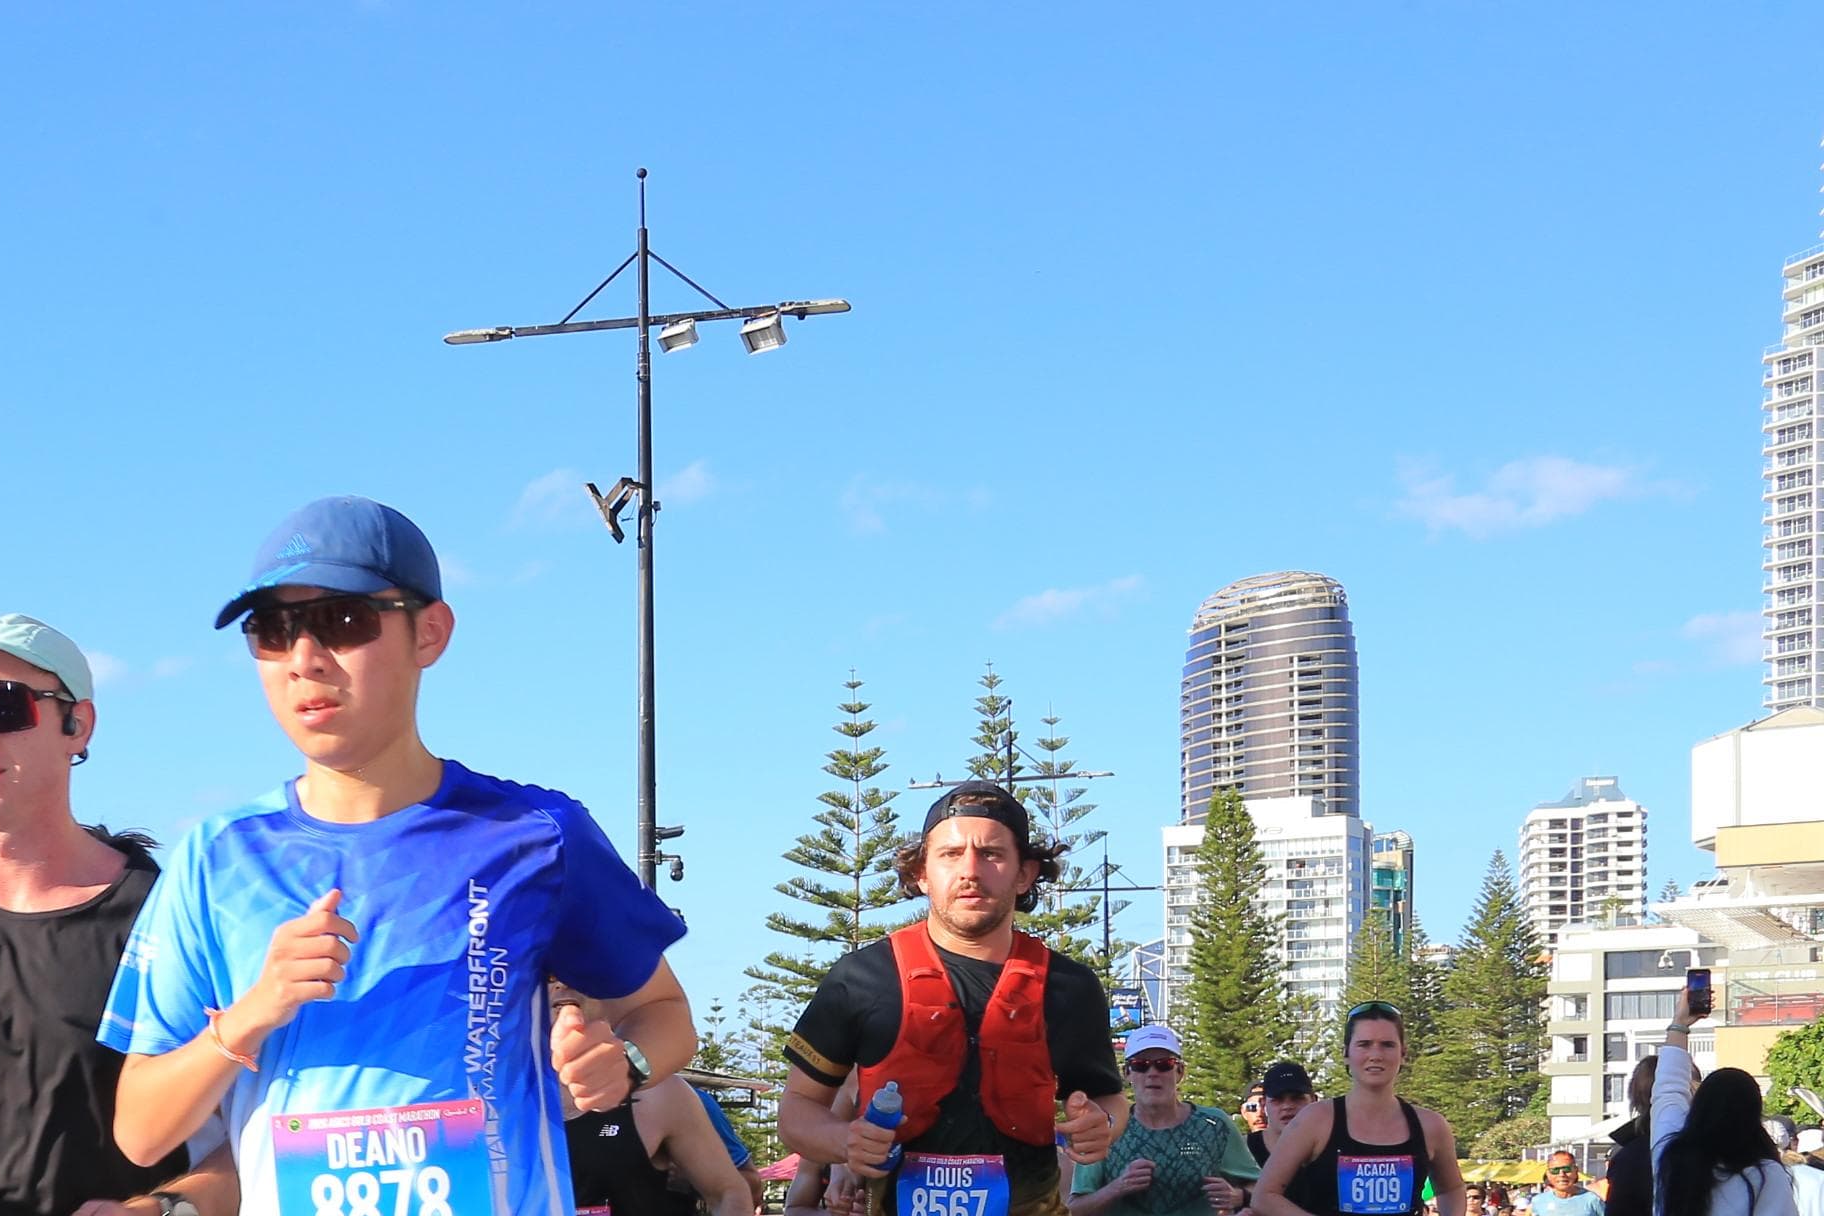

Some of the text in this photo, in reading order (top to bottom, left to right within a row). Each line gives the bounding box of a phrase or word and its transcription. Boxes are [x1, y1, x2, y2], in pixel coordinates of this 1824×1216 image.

[463, 878, 490, 1074] WATERFRONT
[481, 947, 510, 1100] MARATHON
[327, 1126, 426, 1169] DEANO
[926, 1166, 973, 1188] LOUIS
[1356, 1163, 1396, 1177] ACACIA
[1351, 1178, 1400, 1204] 6109
